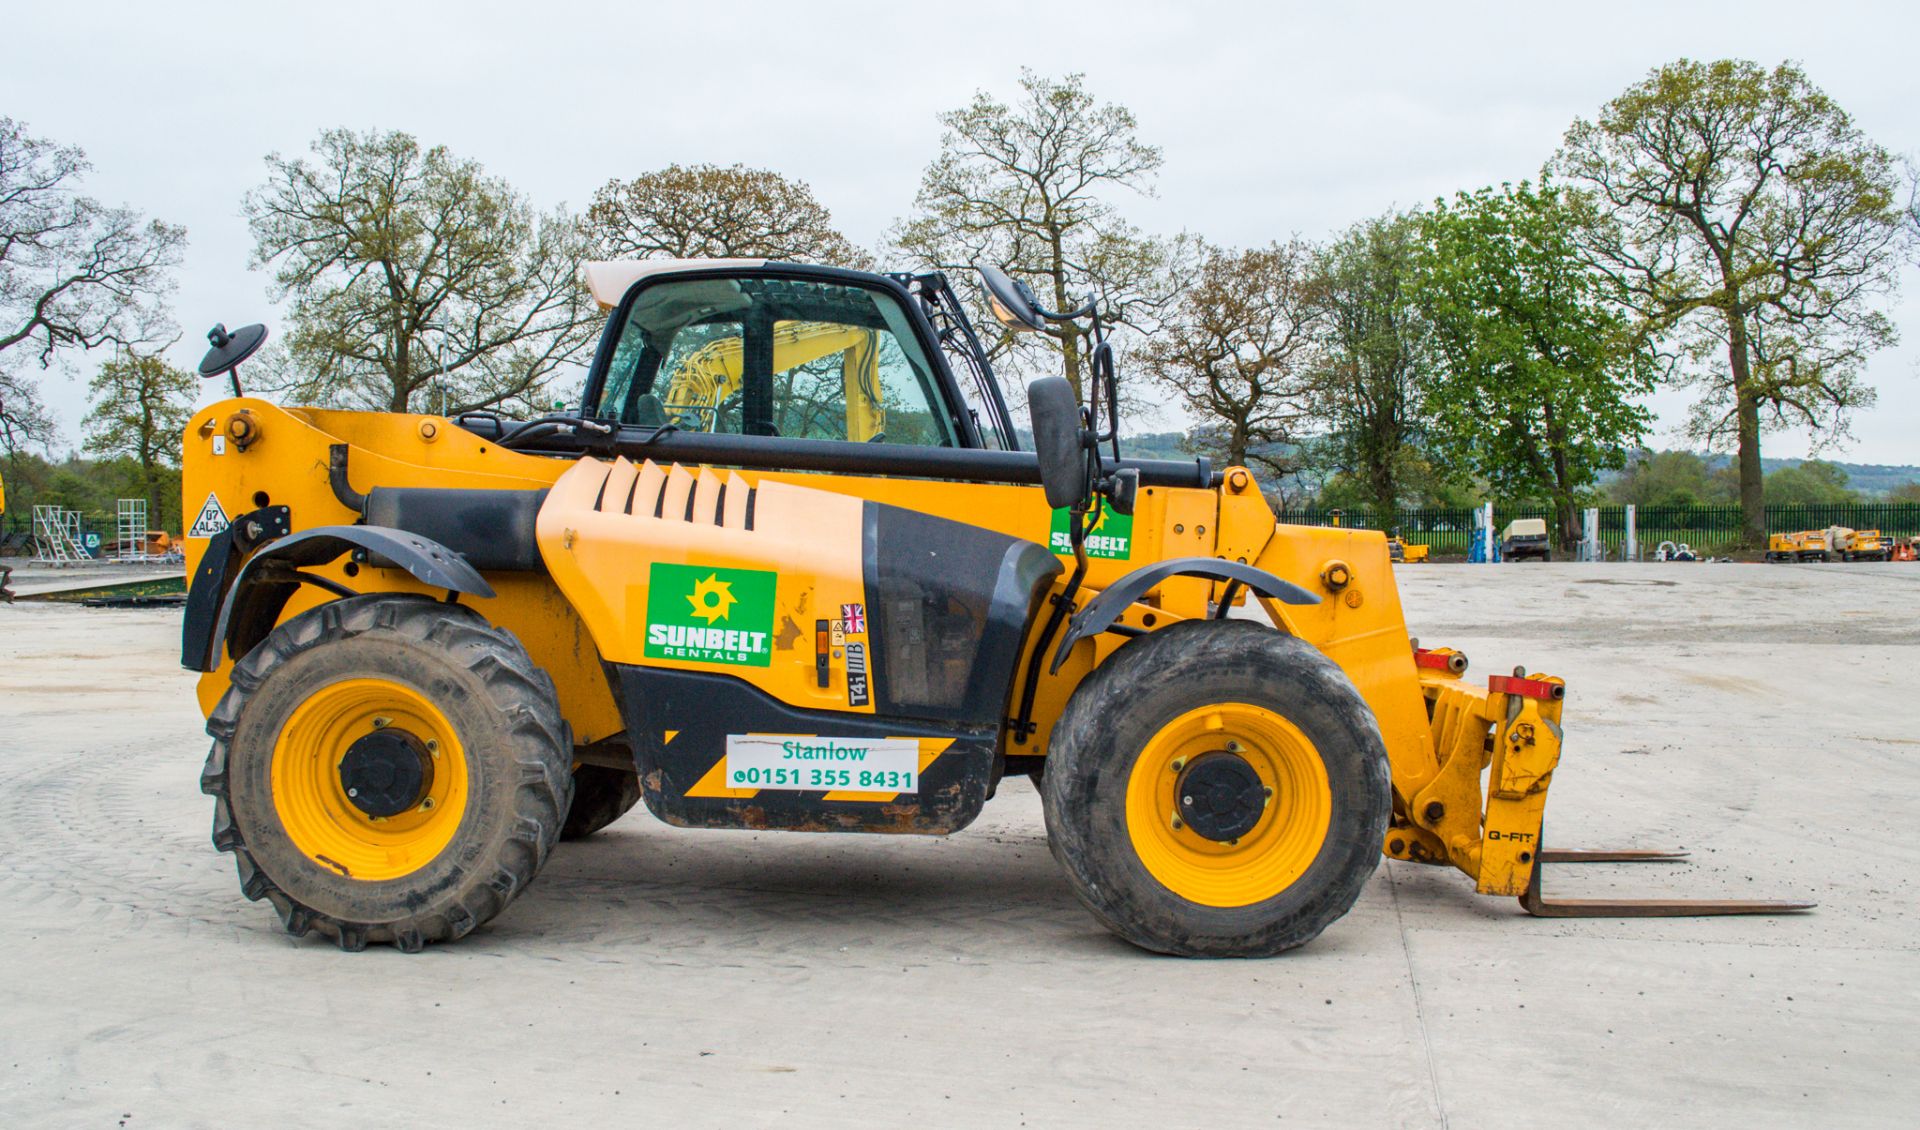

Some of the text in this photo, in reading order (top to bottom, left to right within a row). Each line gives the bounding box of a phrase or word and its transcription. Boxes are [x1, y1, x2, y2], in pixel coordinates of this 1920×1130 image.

[1051, 532, 1127, 552] SUBELT
[1061, 547, 1115, 556] RETALS
[648, 623, 766, 653] SUNBELT
[664, 647, 747, 661] RENTALS
[782, 741, 867, 760] Stanlow
[747, 767, 912, 788] 0151 355 8431
[1489, 831, 1533, 843] Q-FIT
